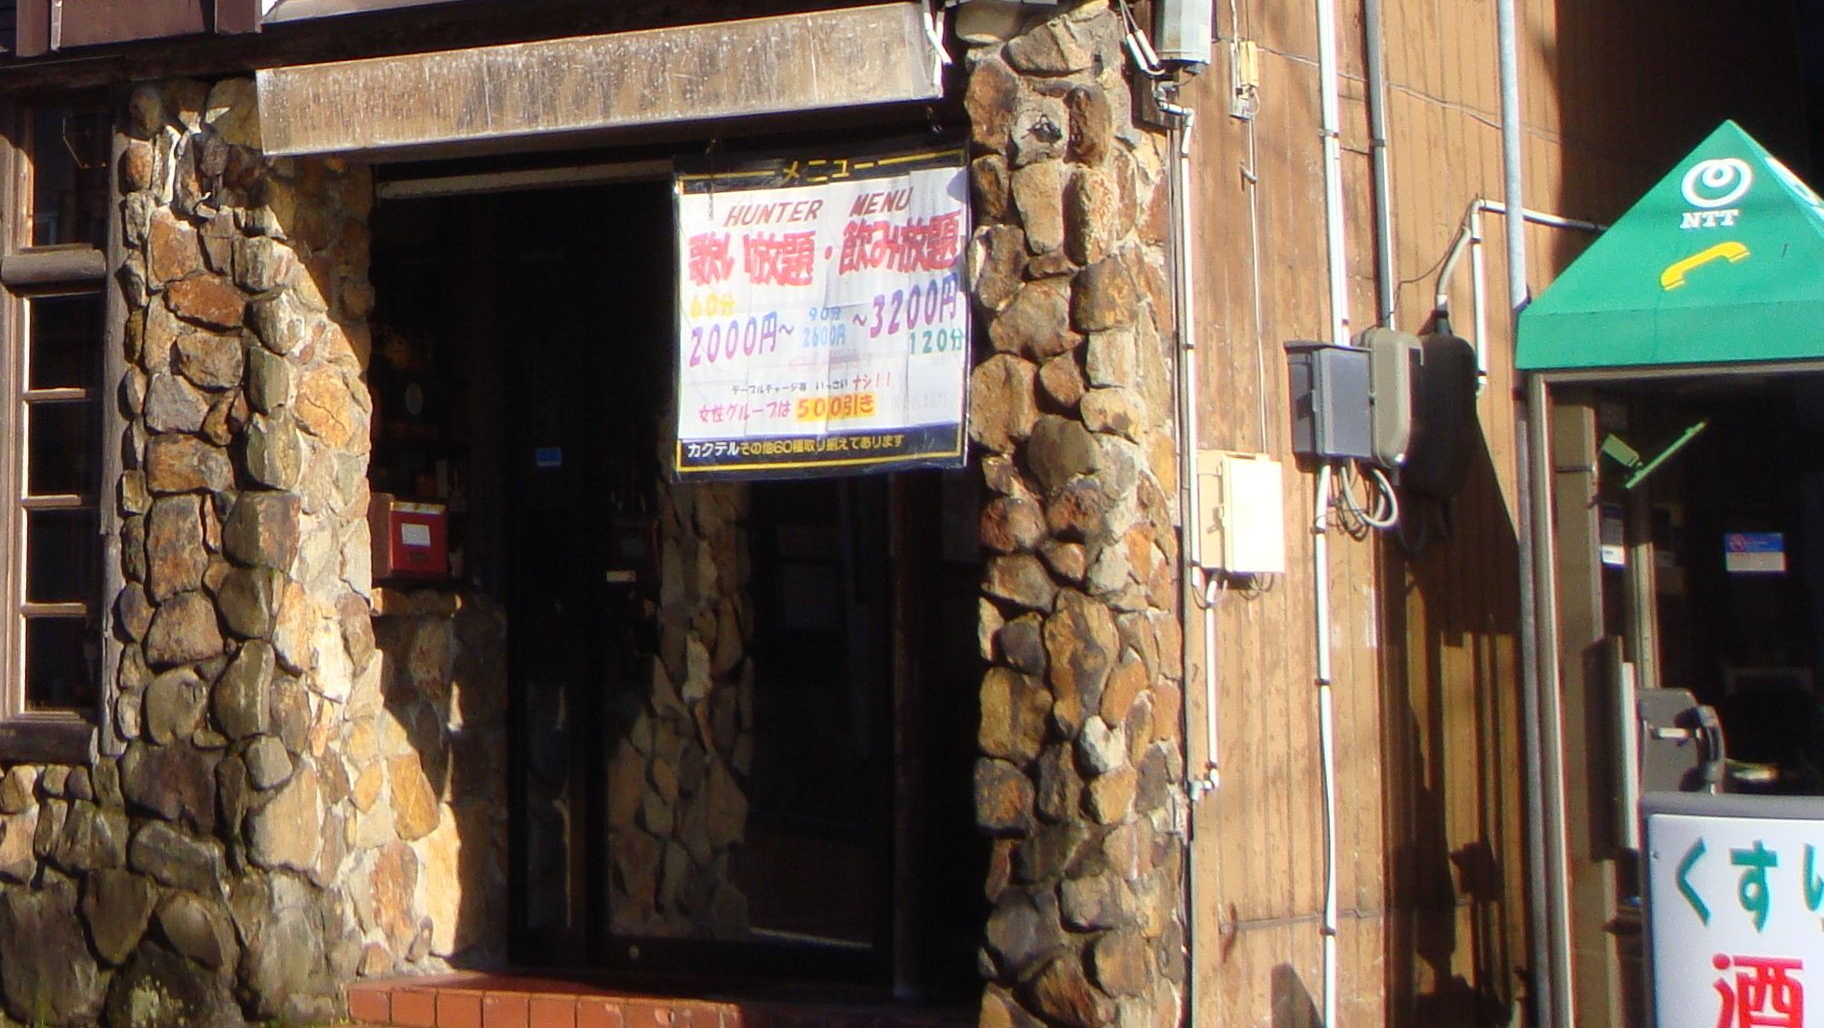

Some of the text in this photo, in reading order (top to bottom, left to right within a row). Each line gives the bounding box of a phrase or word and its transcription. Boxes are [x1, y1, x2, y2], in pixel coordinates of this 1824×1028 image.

[782, 158, 875, 187] メニュー
[722, 187, 914, 227] HUNTER MENU
[1679, 208, 1741, 230] NTT
[908, 327, 964, 356] 120分
[1712, 952, 1804, 1028] 酒
